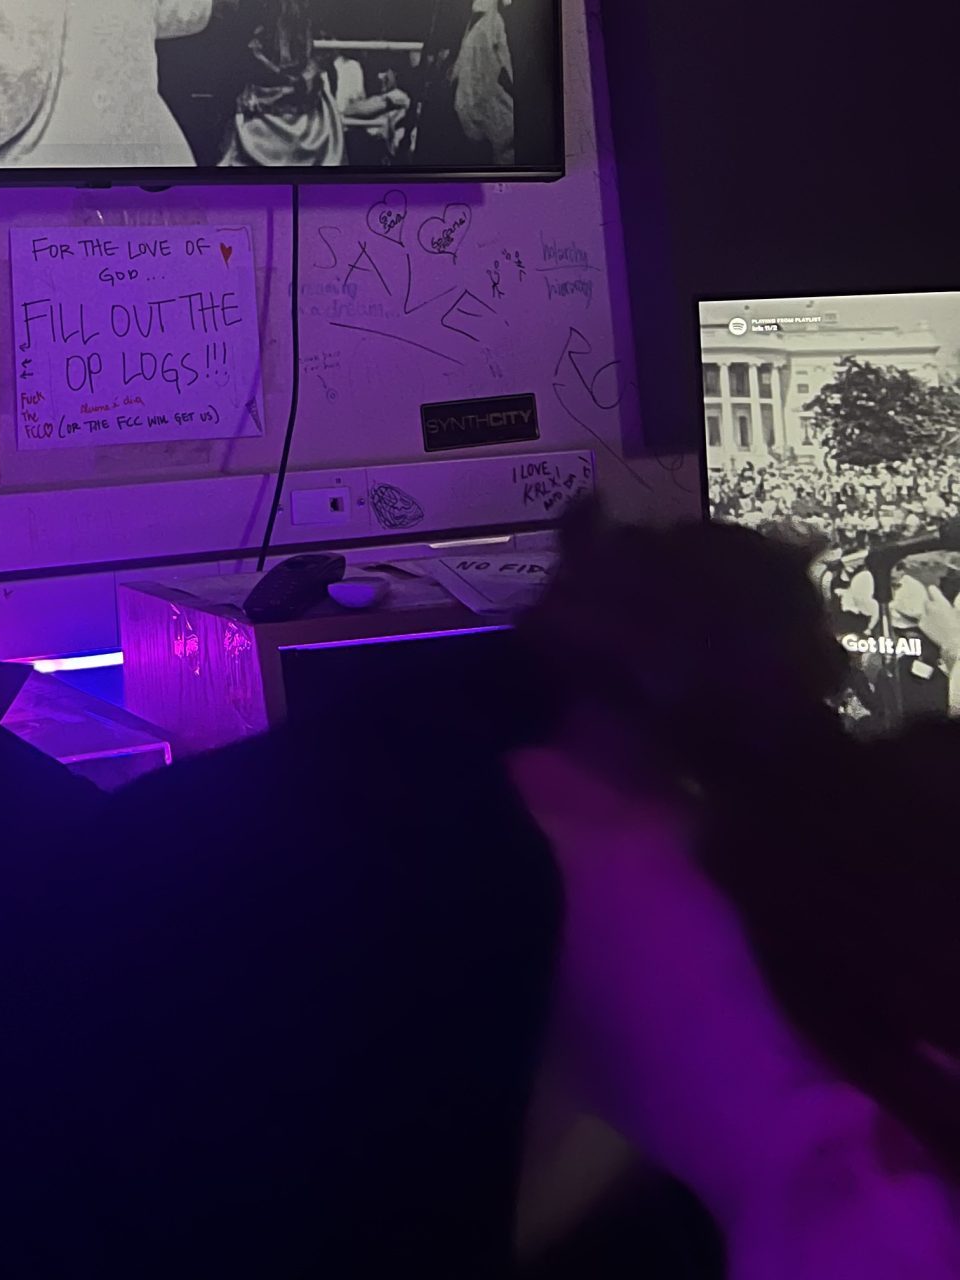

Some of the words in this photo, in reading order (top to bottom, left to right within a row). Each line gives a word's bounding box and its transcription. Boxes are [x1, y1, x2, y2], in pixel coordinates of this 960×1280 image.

[32, 237, 74, 261] FOR
[78, 239, 119, 258] THE
[128, 240, 171, 259] LOVE
[185, 237, 210, 256] OF
[21, 298, 100, 348] FILL
[111, 298, 176, 338] OUT
[179, 292, 242, 333] THE
[66, 352, 103, 394] OP
[122, 342, 229, 394] LOGS!!!
[20, 391, 45, 411] Fuck
[84, 420, 110, 433] THE
[116, 416, 141, 429] FCC
[174, 411, 195, 426] GET
[199, 405, 221, 425] US)
[426, 409, 532, 434] SYNTHCITY
[512, 467, 517, 484] I
[520, 461, 551, 480] LOVE
[456, 561, 491, 571] NO
[842, 634, 876, 654] Got
[879, 636, 894, 656] It
[895, 637, 921, 656] All
